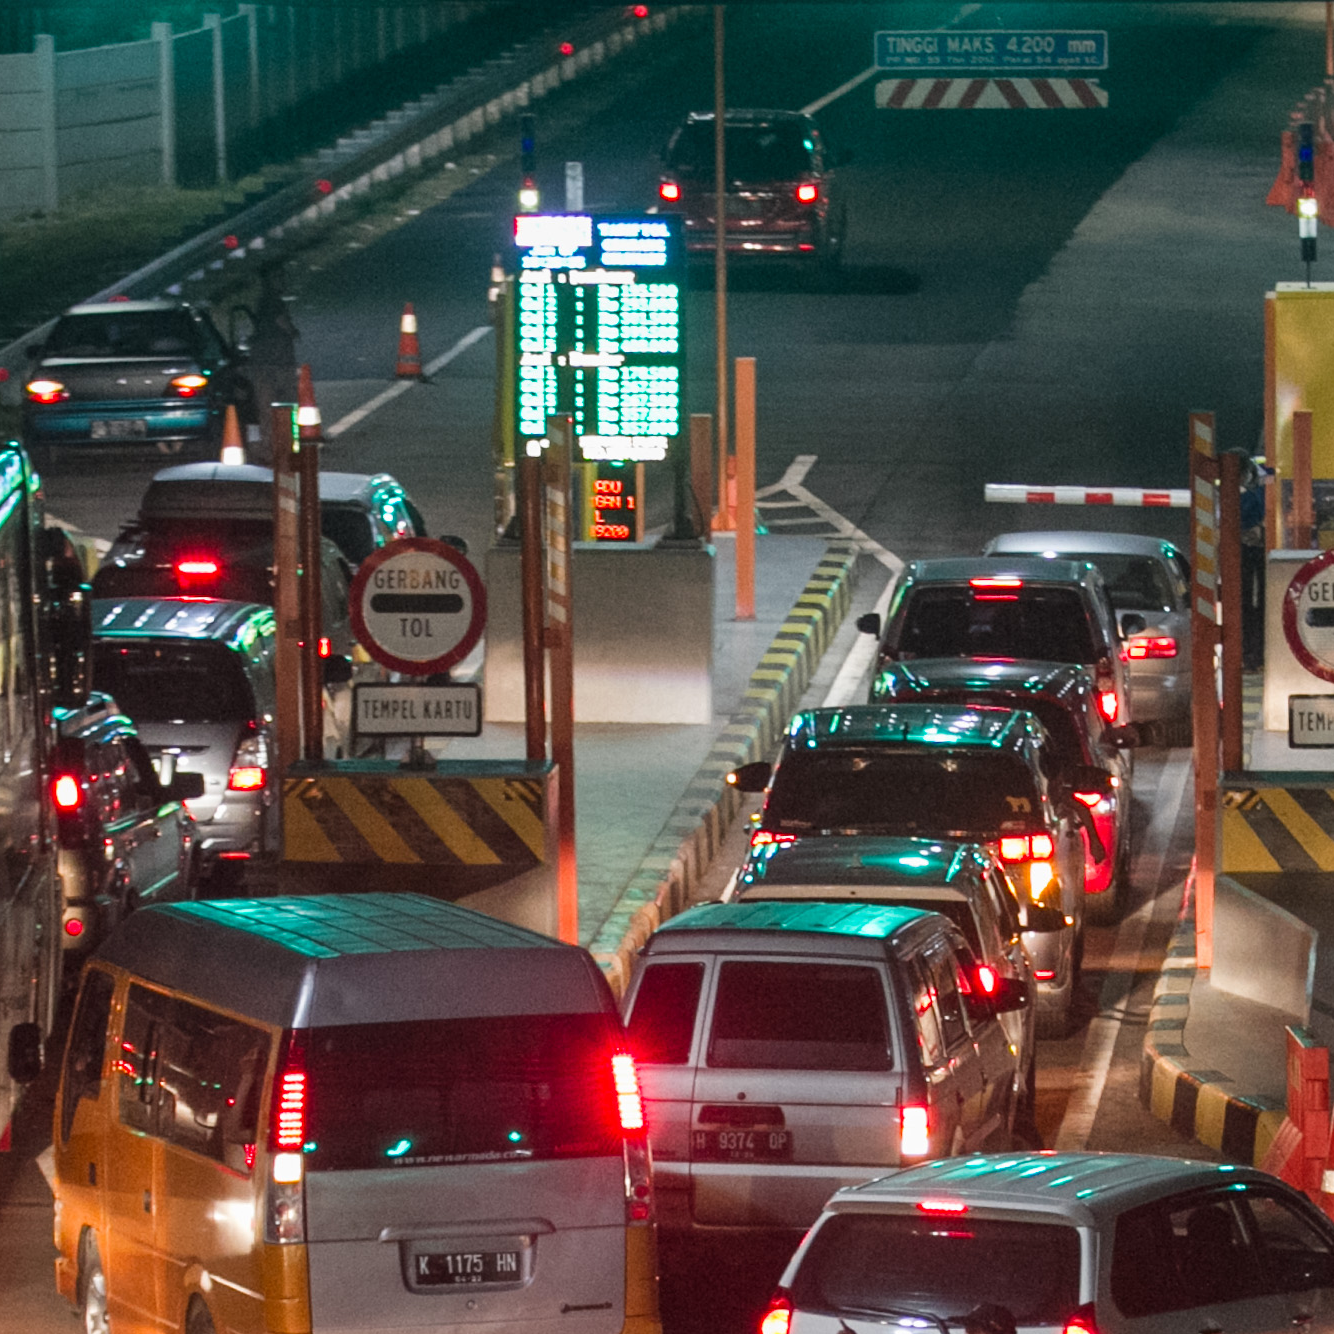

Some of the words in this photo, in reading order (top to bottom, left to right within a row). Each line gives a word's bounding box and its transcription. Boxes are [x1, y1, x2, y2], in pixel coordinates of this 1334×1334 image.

[886, 36, 938, 53] TINGGI
[1068, 40, 1096, 53] mm
[374, 569, 460, 590] GERBANG
[400, 618, 433, 638] TOL
[363, 700, 417, 720] TEMPEL
[424, 700, 473, 720] KARTU
[696, 1134, 706, 1149] H
[719, 1132, 754, 1150] 9374
[419, 1256, 430, 1275] K
[446, 1254, 483, 1274] 1175
[496, 1253, 517, 1272] HN
